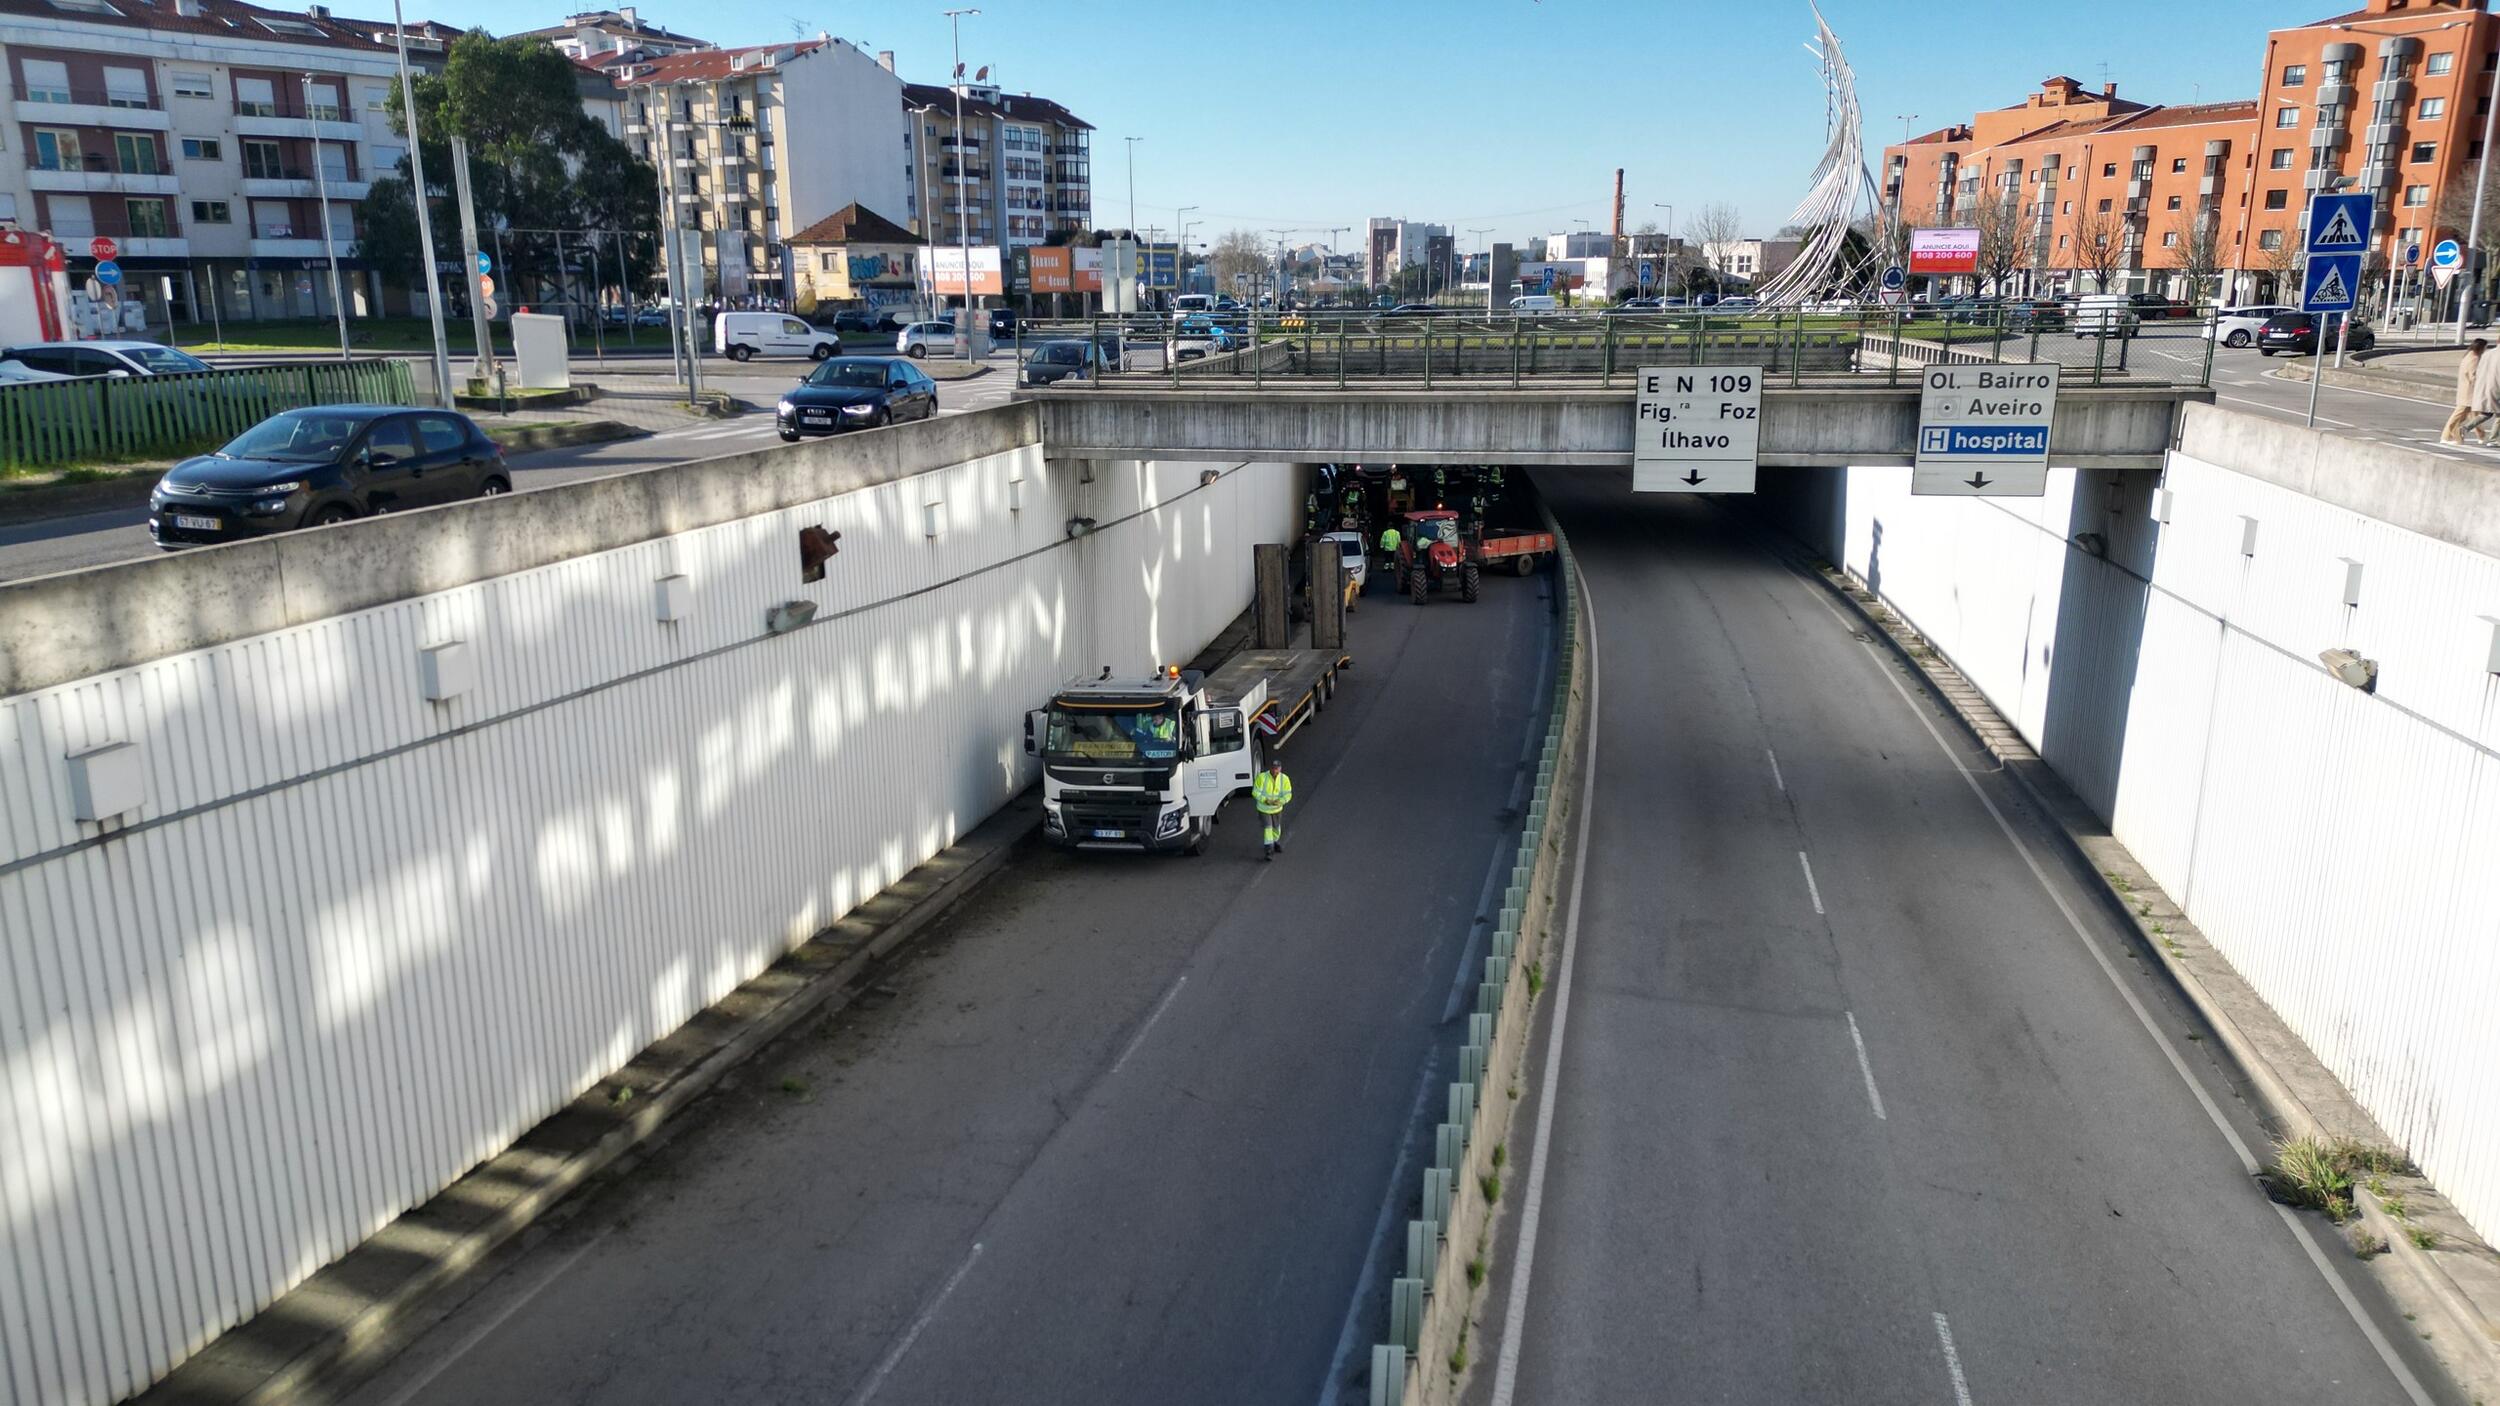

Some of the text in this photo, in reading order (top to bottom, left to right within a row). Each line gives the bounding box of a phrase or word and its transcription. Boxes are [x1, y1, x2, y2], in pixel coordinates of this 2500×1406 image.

[91, 244, 117, 254] STOP
[1647, 375, 1752, 393] E N 109
[1930, 372, 2050, 389] Ol. Bairro
[1720, 403, 1756, 419] Foz
[1968, 398, 2042, 415] Aveiro
[1662, 427, 1729, 448] Ílhavo
[1955, 432, 2043, 451] hospital
